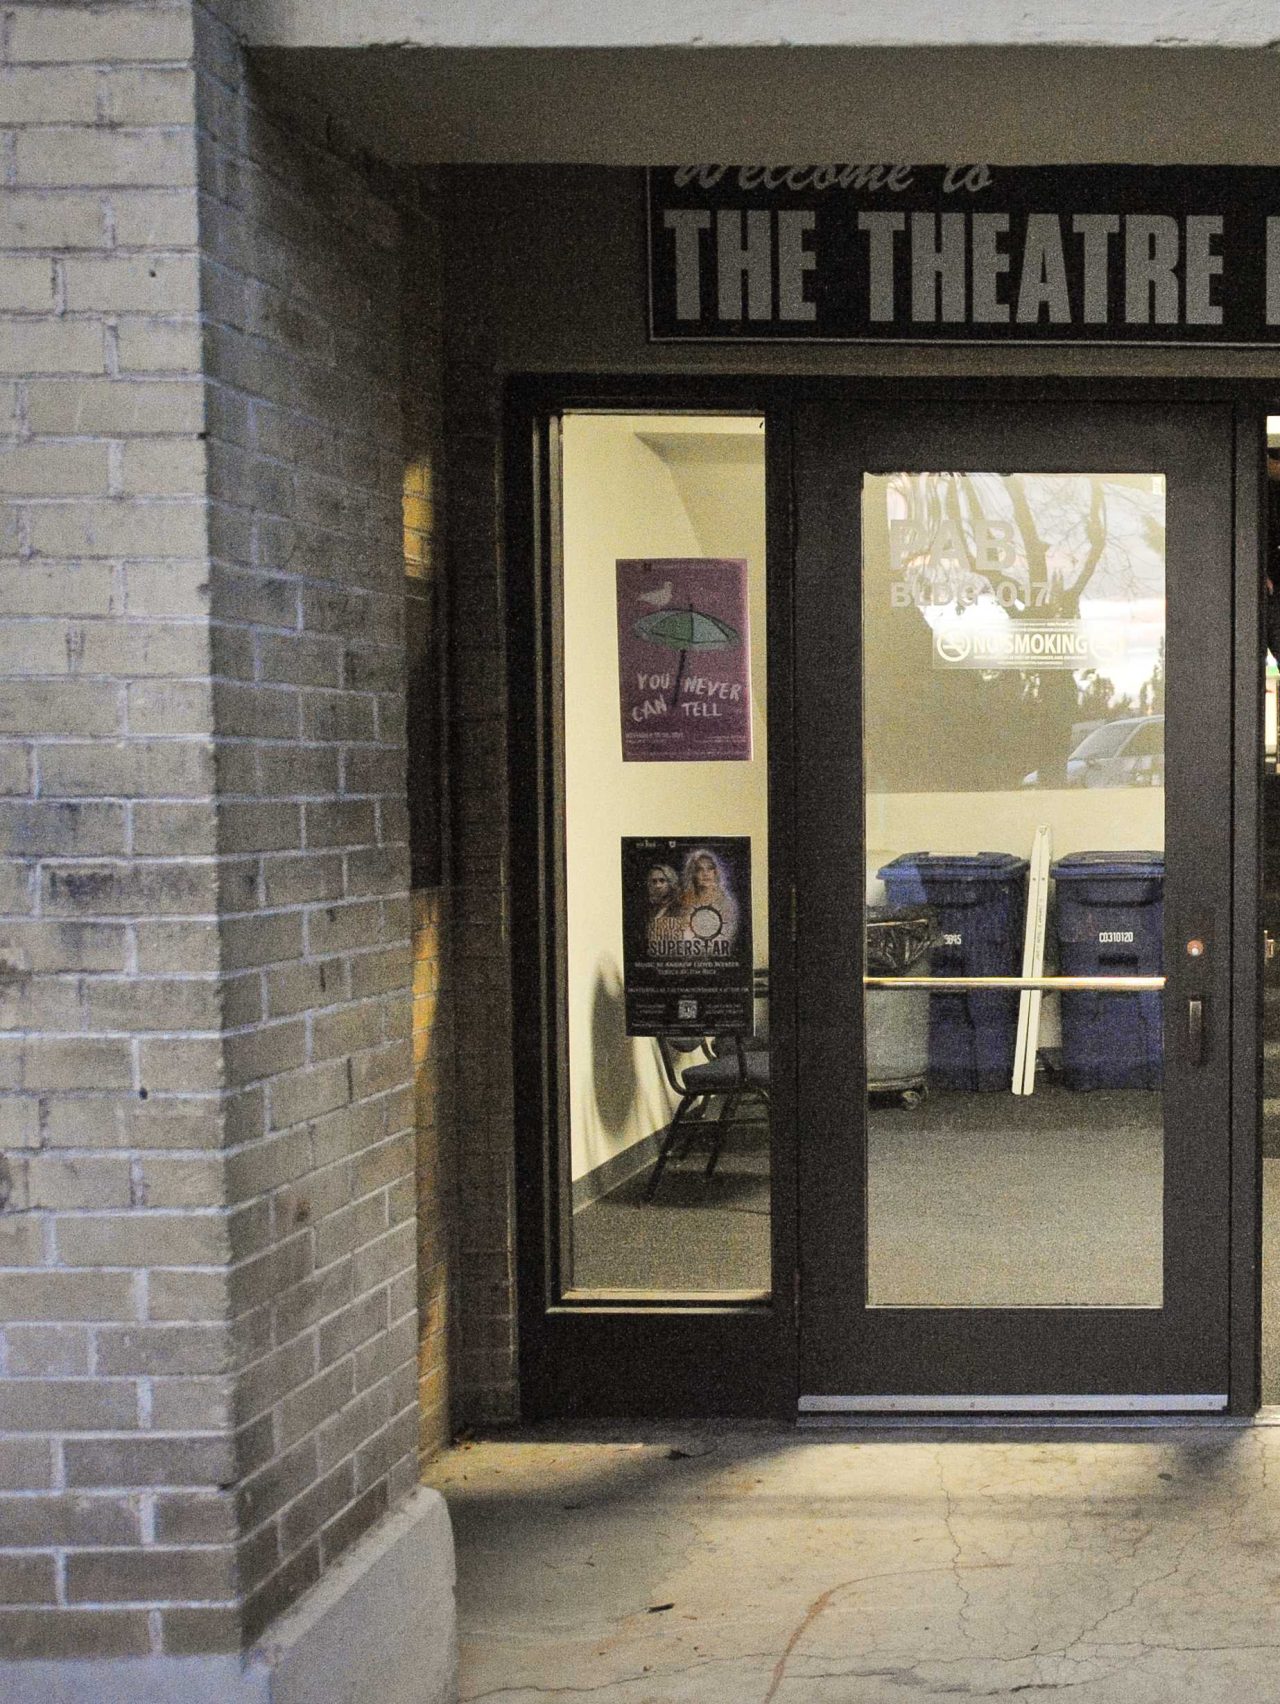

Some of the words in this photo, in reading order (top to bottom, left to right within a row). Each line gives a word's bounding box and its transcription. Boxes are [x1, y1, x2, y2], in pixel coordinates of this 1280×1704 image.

[663, 209, 818, 321] THE
[858, 211, 1224, 325] THEATRE
[890, 519, 1017, 571] PAB
[891, 582, 980, 608] BLDG
[997, 581, 1051, 608] 017
[1003, 633, 1088, 654] SMOKING
[636, 672, 670, 690] YOU
[684, 676, 742, 700] NEVER
[632, 694, 667, 722] CAN
[681, 702, 722, 717] TELL
[650, 940, 730, 956] SUPERSTAR
